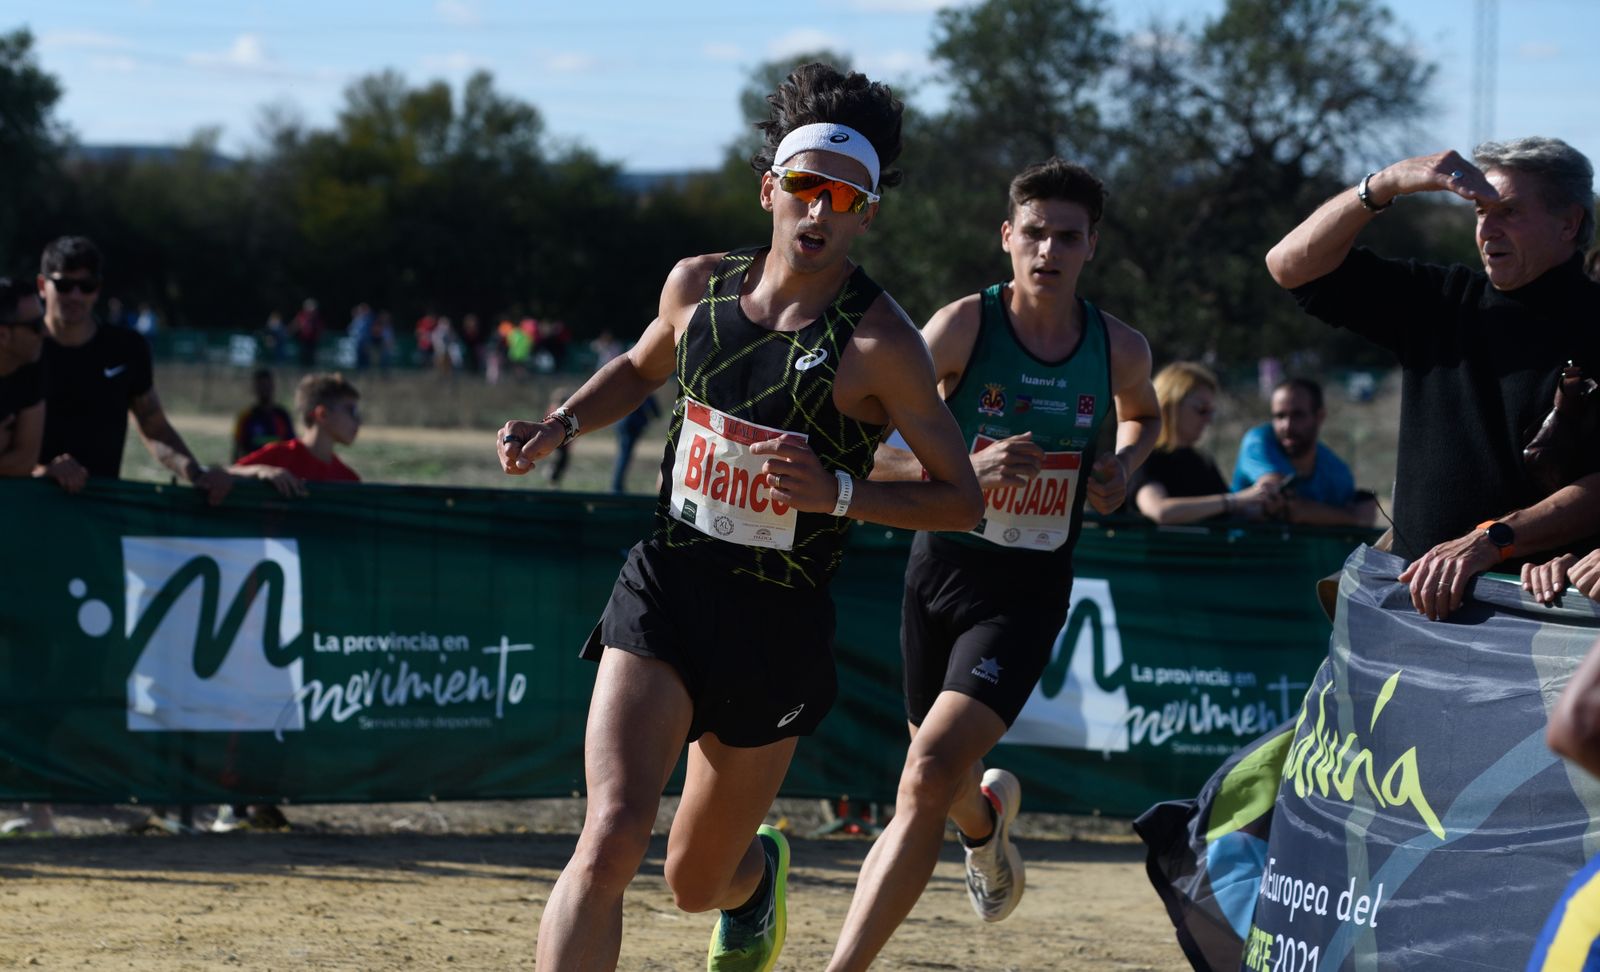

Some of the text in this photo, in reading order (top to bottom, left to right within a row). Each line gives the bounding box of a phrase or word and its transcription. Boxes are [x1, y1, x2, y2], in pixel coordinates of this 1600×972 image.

[983, 477, 1070, 517] UIJADA
[313, 631, 470, 655] La provincia en
[276, 635, 535, 738] movimiento
[1131, 663, 1256, 688] La provincia en
[1104, 674, 1308, 758] movimient
[1267, 857, 1329, 923] Europea
[1336, 876, 1384, 928] del
[1273, 933, 1320, 972] 2021
